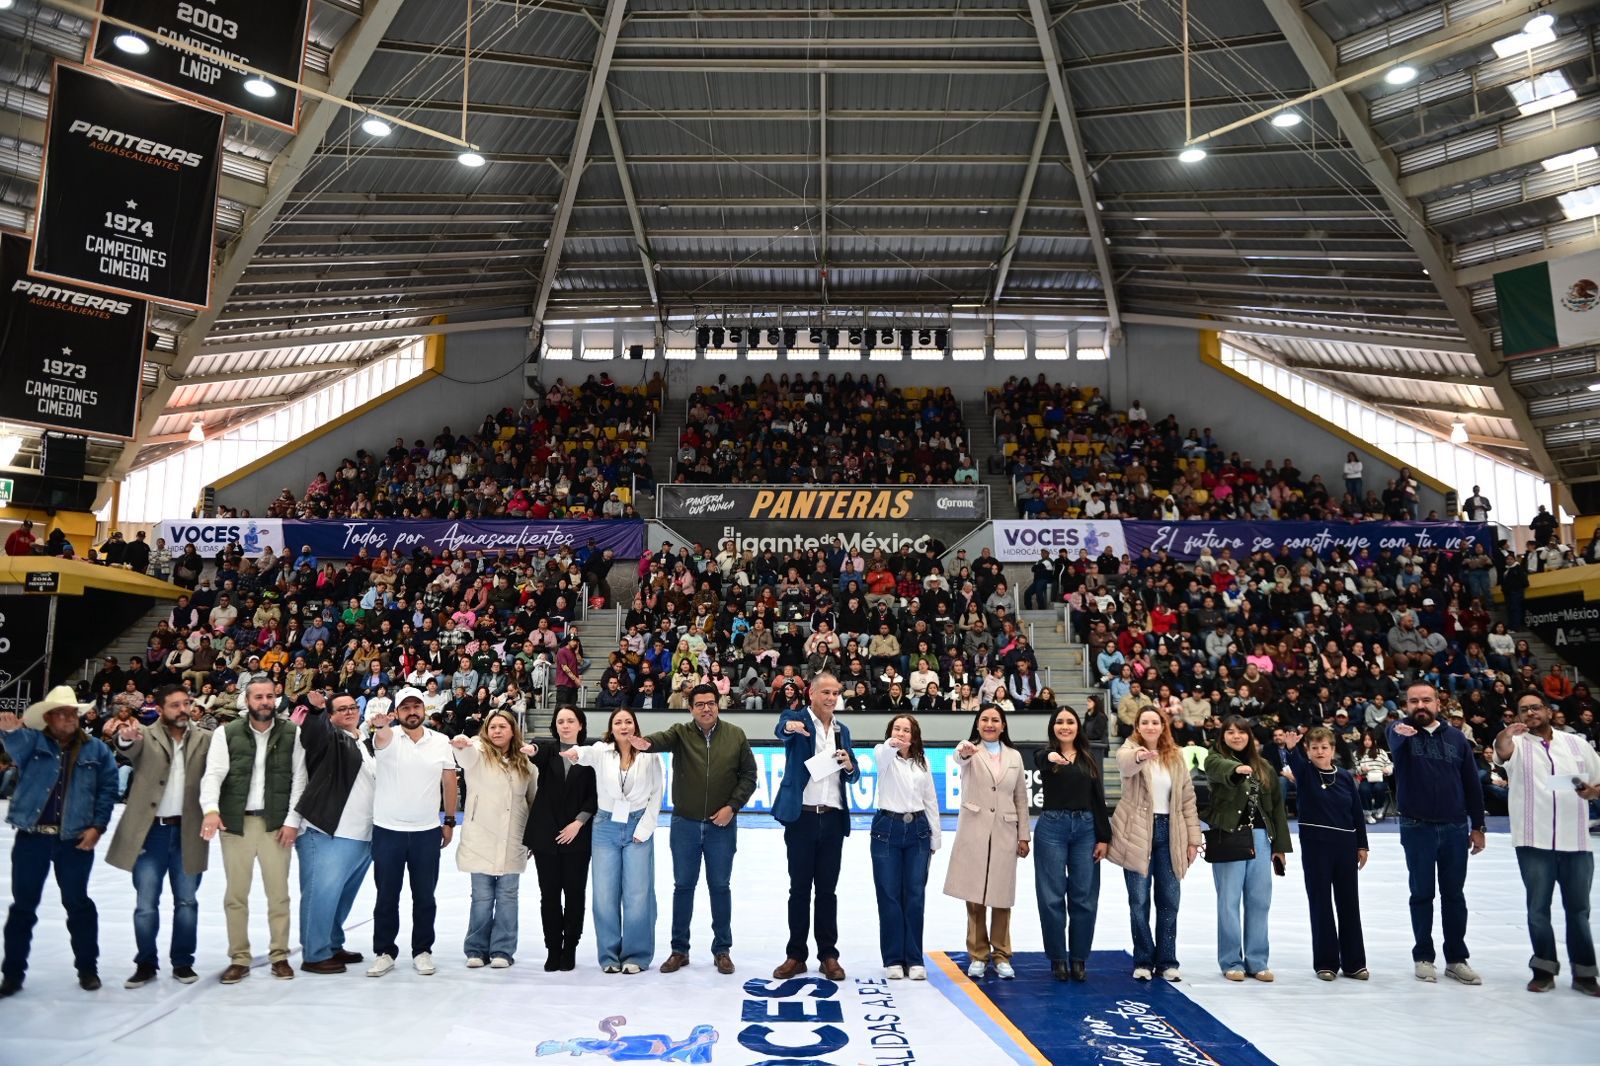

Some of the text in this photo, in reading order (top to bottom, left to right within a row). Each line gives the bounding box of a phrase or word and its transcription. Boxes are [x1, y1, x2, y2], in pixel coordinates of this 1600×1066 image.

[176, 2, 239, 40] 2003
[156, 26, 250, 76] CAMPEONES
[179, 56, 222, 85] LNBP
[68, 119, 204, 168] PANTERAS
[89, 140, 181, 171] AGUASCALIENTES
[104, 211, 154, 238] 1974
[85, 235, 167, 268] CAMPEONES
[99, 256, 150, 283] CIMEBA
[11, 279, 132, 315] PANTERAS
[30, 297, 111, 320] AGUASCALIENTES
[42, 358, 87, 380] 1973
[25, 380, 98, 405] CAMPEONES
[37, 398, 82, 419] CIMEBA
[688, 505, 705, 515] QUE
[749, 489, 914, 519] PANTERAS
[936, 497, 976, 511] Corona
[170, 526, 240, 543] VOCES
[342, 522, 575, 551] Todos por Aguascalientes
[723, 526, 734, 537] El
[838, 531, 929, 554] México
[1004, 528, 1079, 546] VOCES
[1150, 526, 1178, 553] El
[1184, 527, 1244, 554] futuro
[1251, 536, 1275, 552] se
[1379, 536, 1412, 549] con
[1563, 607, 1600, 622] México
[1555, 627, 1568, 647] A
